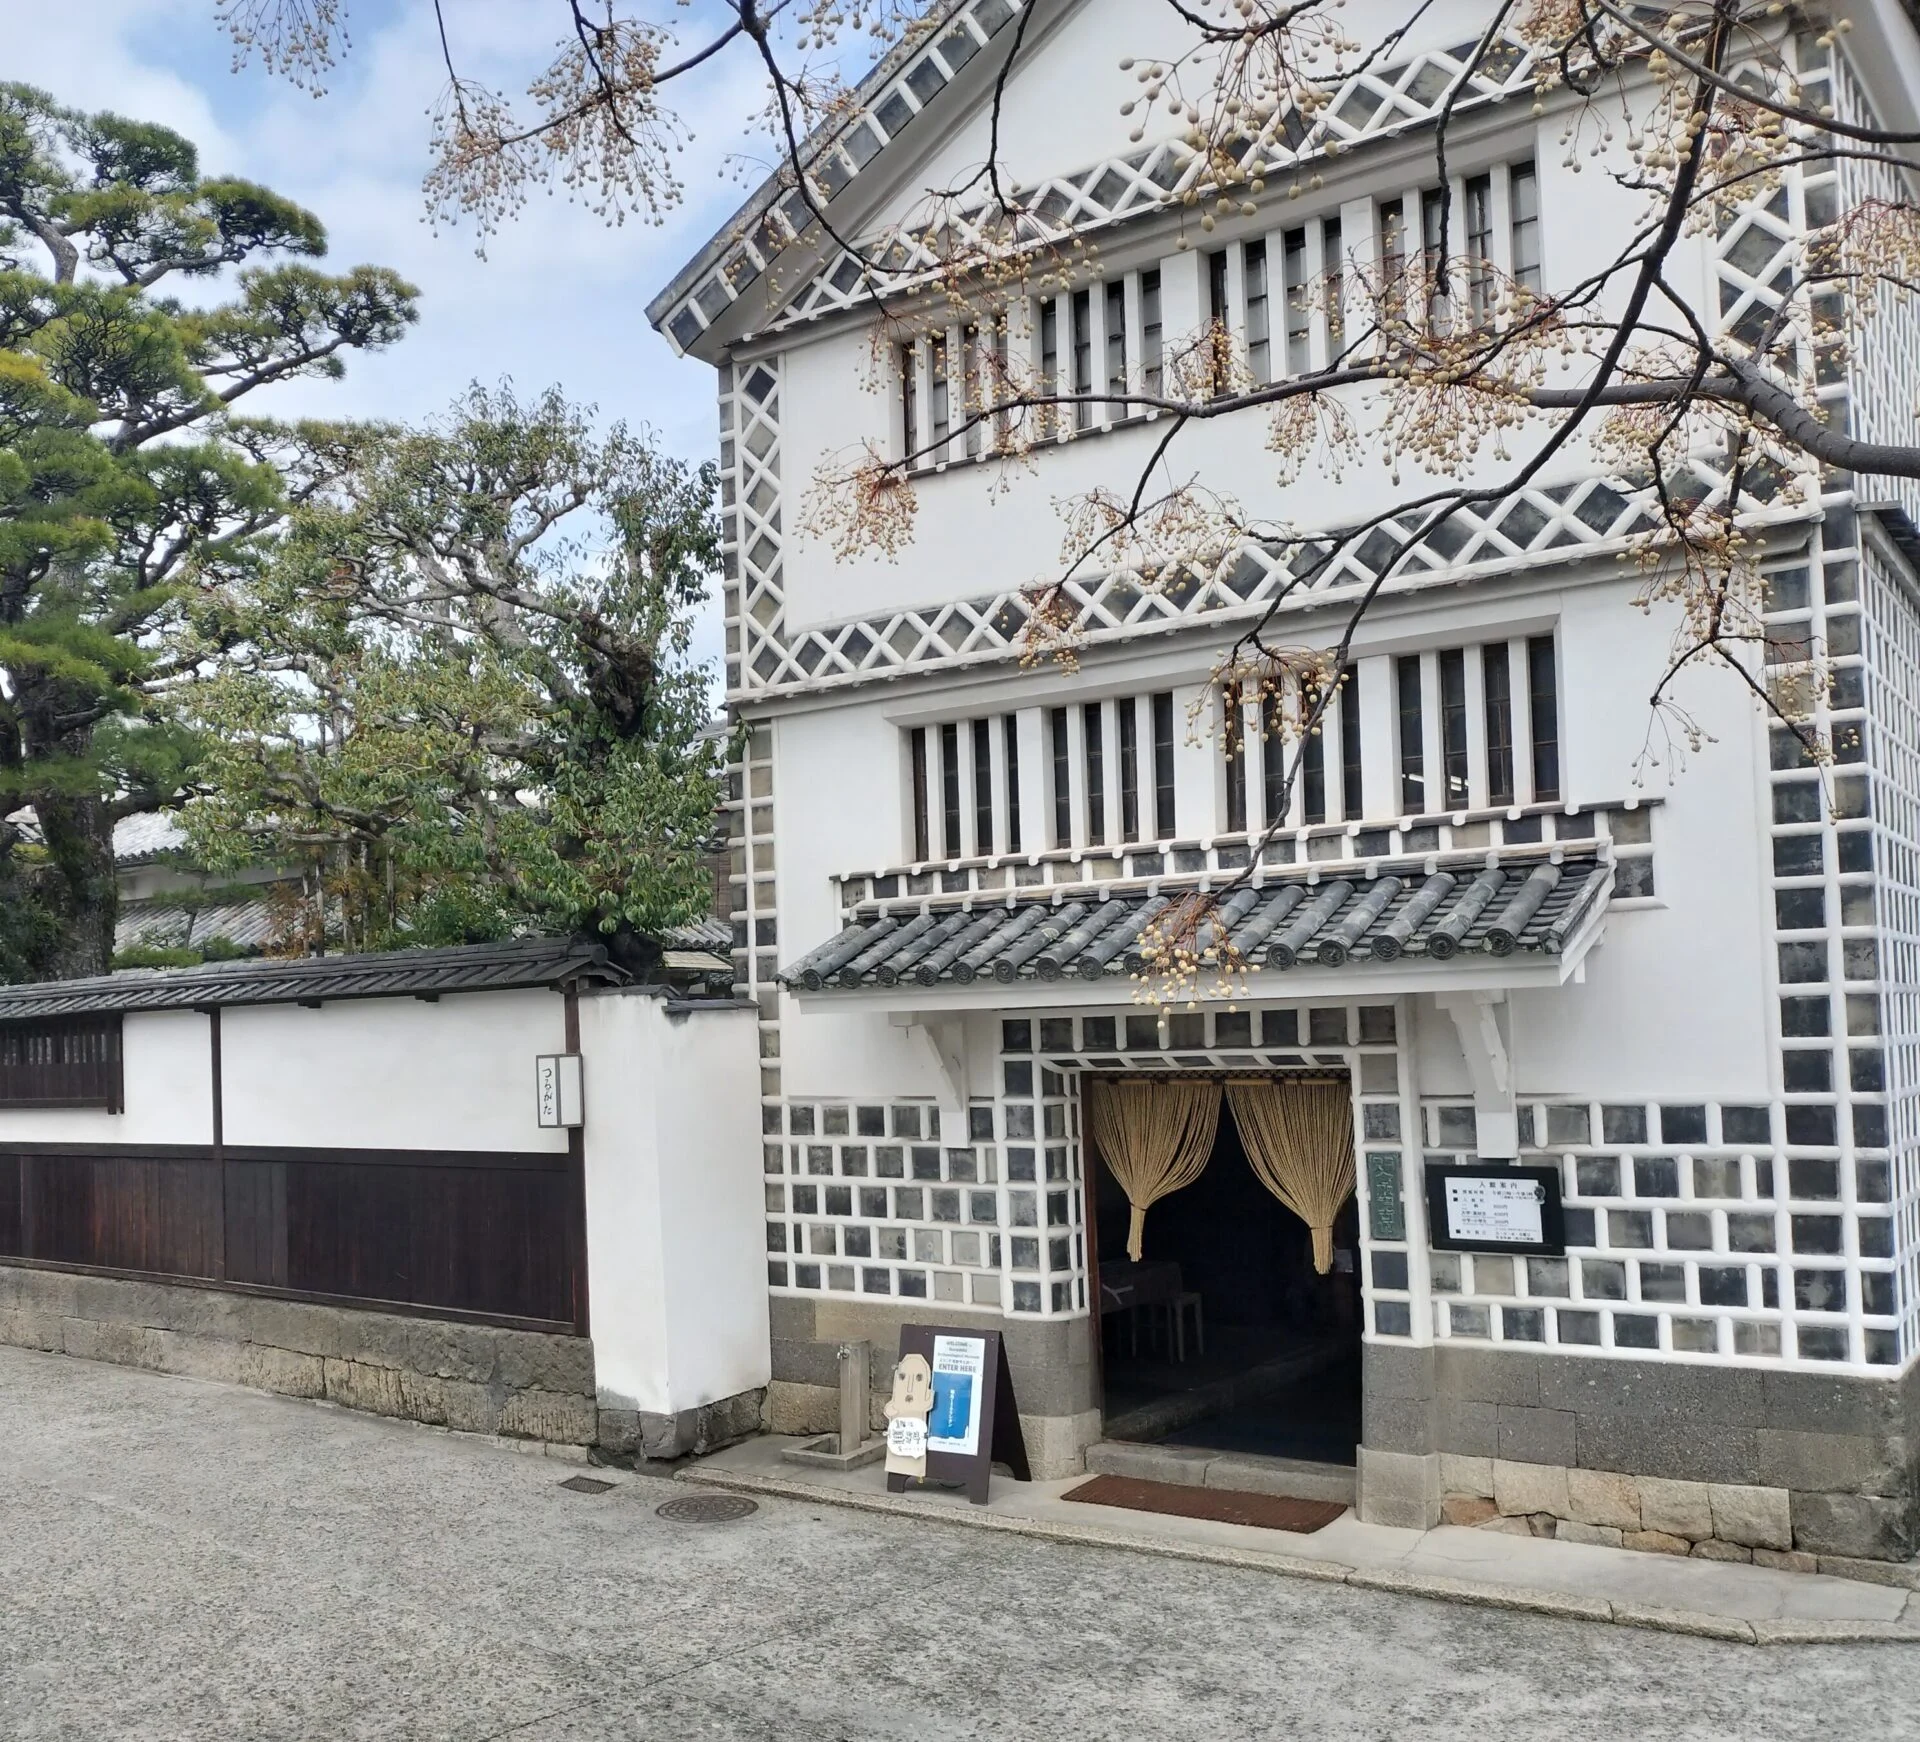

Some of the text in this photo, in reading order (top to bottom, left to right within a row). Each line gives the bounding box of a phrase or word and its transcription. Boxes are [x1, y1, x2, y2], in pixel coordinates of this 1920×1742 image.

[542, 1068, 553, 1115] つるがた
[938, 1363, 977, 1373] ENTER HERE
